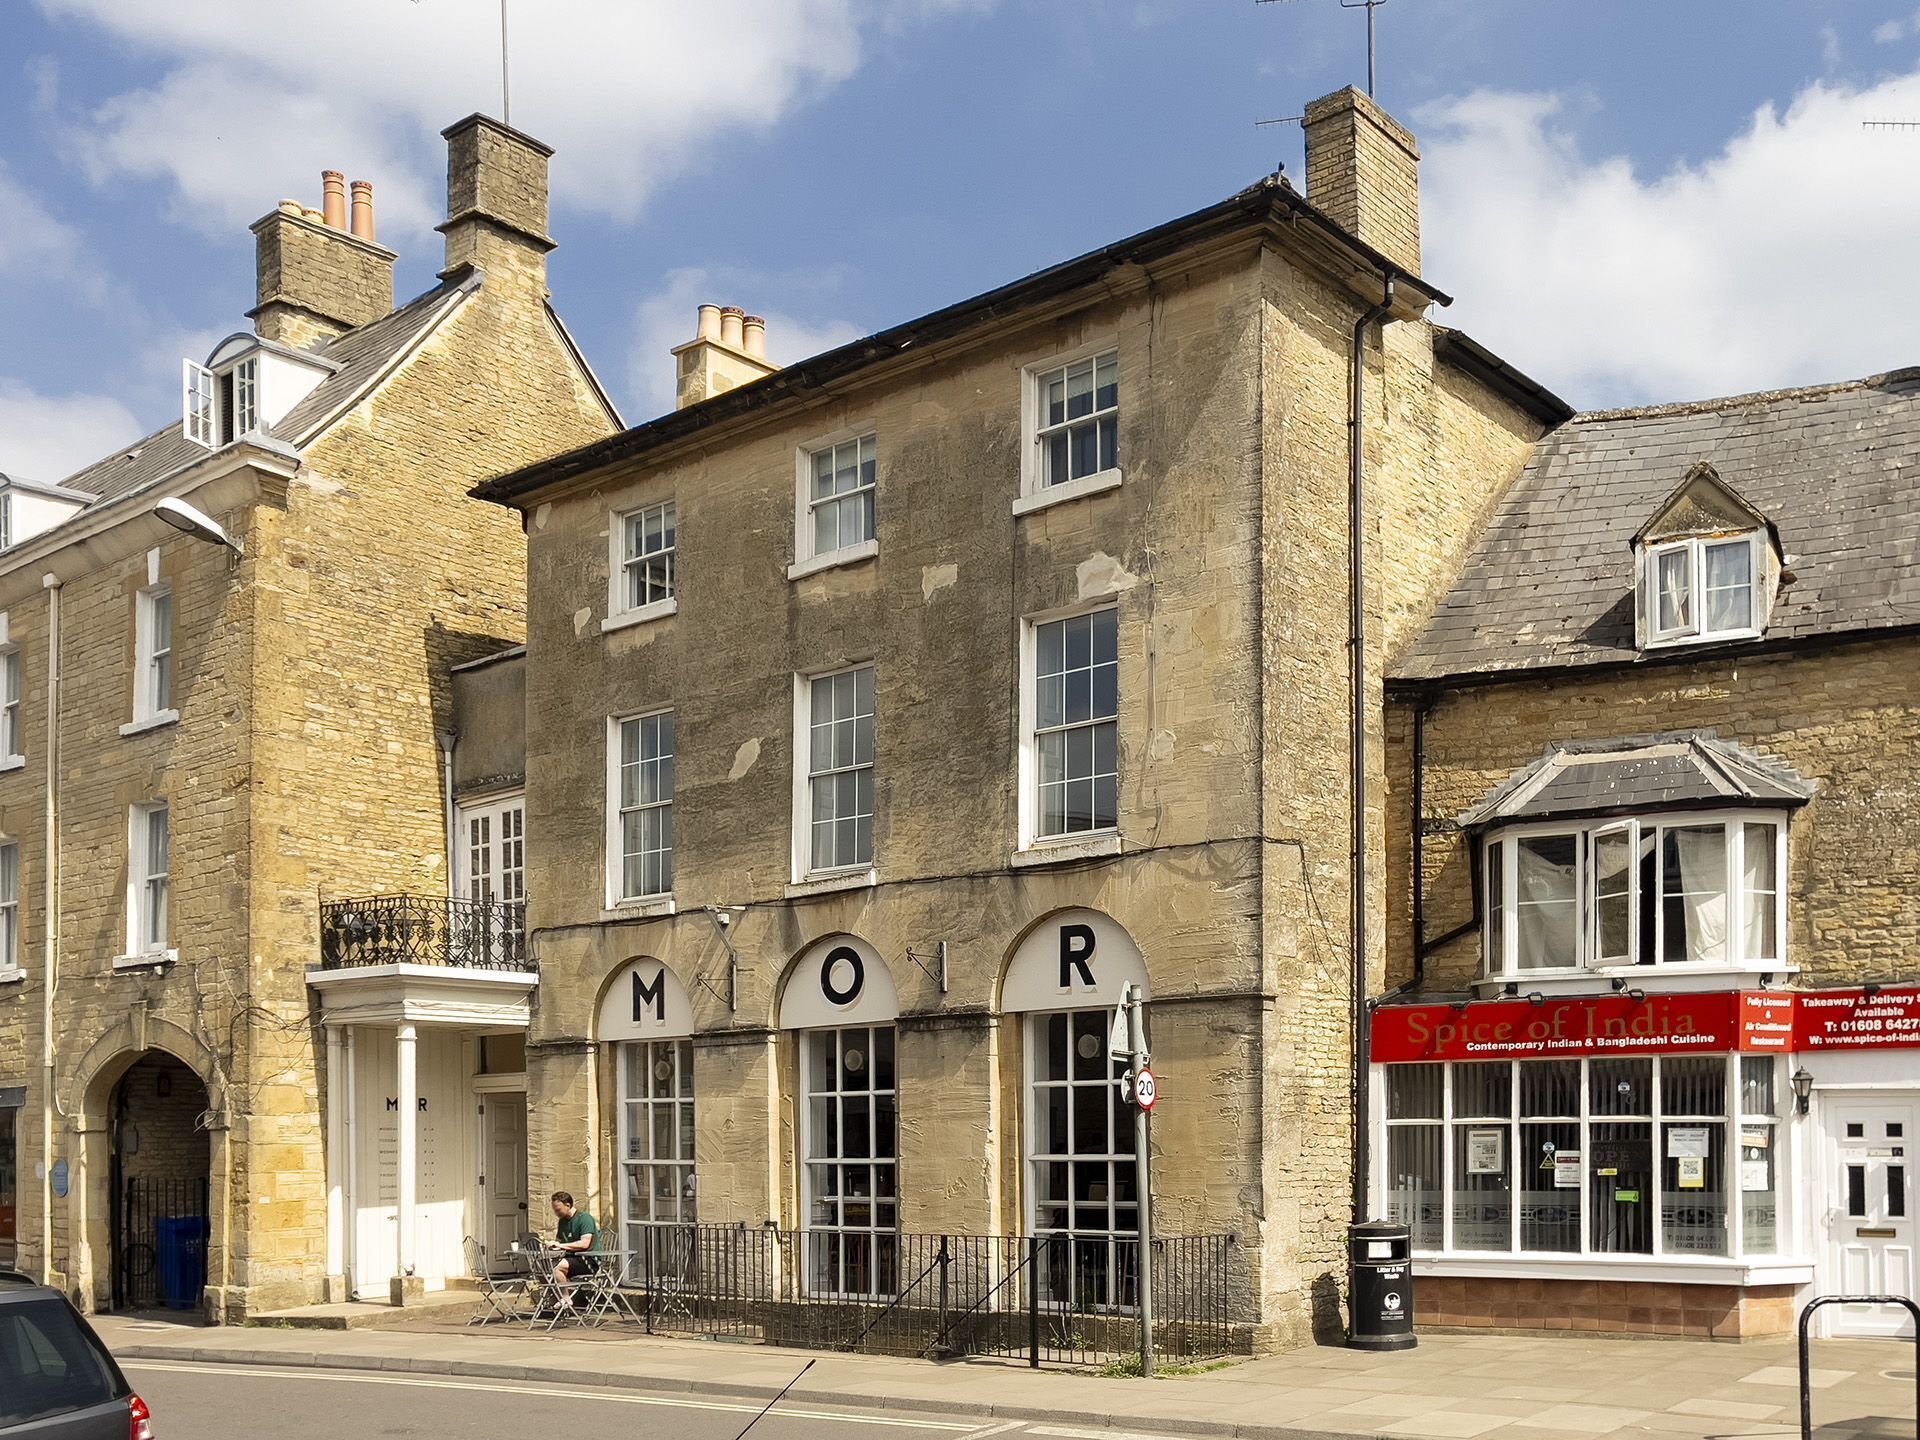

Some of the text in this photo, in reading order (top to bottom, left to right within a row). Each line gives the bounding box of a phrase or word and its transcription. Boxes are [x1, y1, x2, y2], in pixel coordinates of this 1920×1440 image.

[632, 924, 1098, 1022] M O R
[1746, 997, 1792, 1007] Fully Licensed
[1801, 998, 1855, 1008] Takeaway
[1858, 997, 1866, 1005] &
[1869, 994, 1914, 1005] Delivery
[1765, 1010, 1771, 1019] &
[1854, 1006, 1905, 1017] Available
[1407, 1002, 1697, 1053] Spice of India
[1745, 1022, 1792, 1031] Air Conditioned
[1824, 1018, 1920, 1032] T: 01608 6427
[1466, 1034, 1716, 1051] Contemporary Indian & Bangladeshi Cuisine
[1750, 1036, 1785, 1046] Restaurant
[1809, 1032, 1920, 1045] W: www.spice-of-indi
[1139, 1080, 1154, 1096] 20
[386, 1097, 428, 1111] MR
